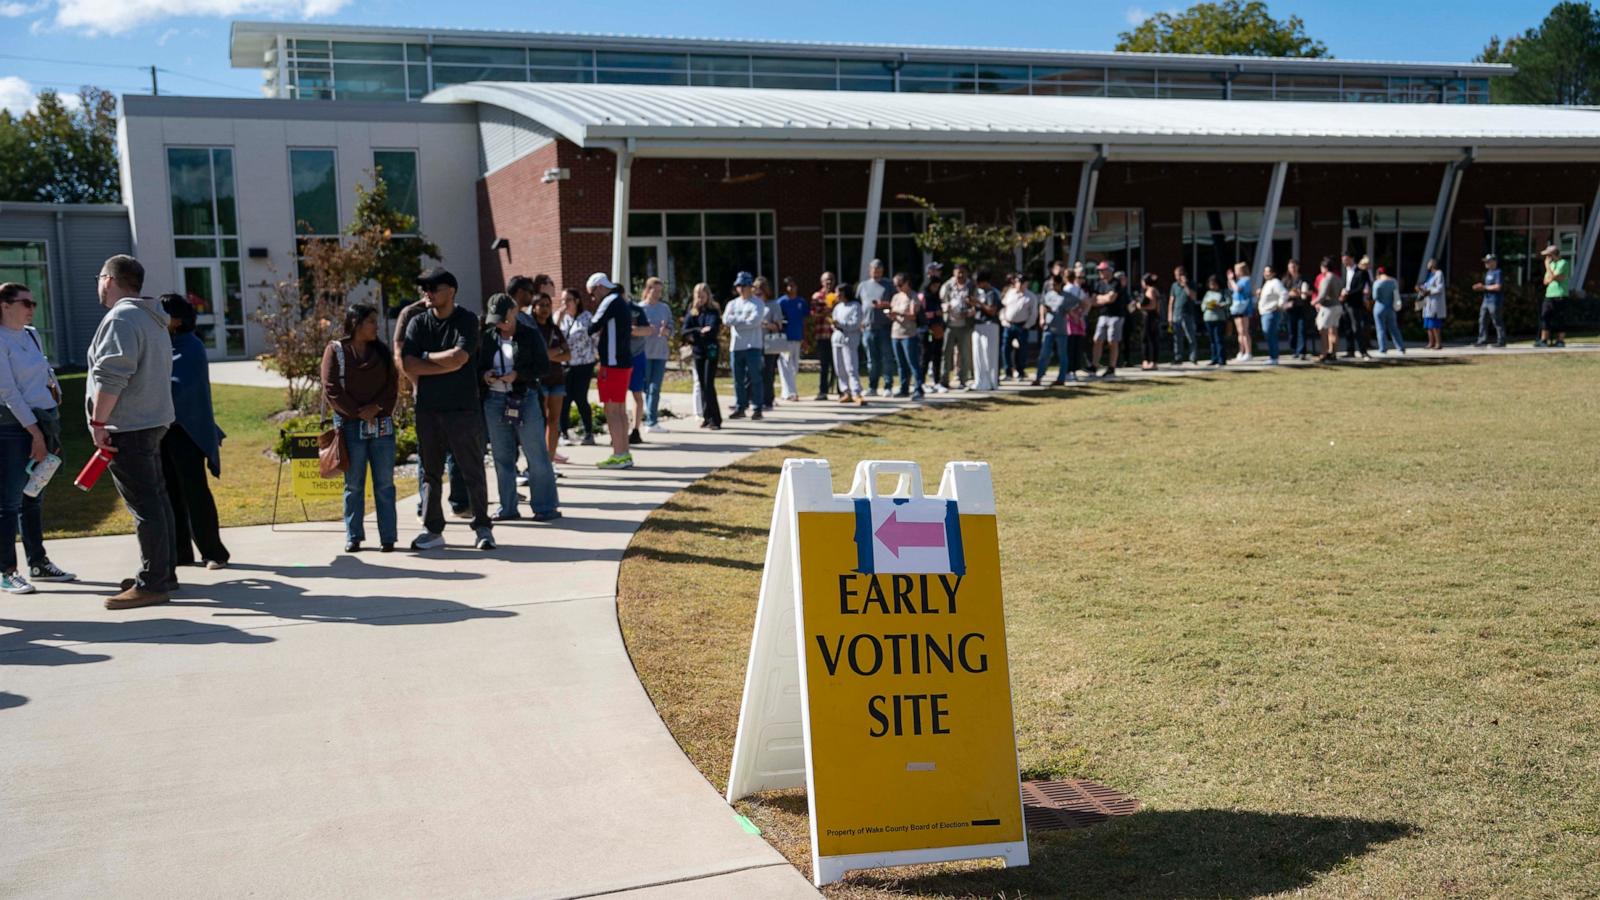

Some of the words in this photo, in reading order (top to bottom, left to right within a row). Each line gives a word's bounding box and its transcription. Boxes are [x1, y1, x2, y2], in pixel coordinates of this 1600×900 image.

[312, 480, 329, 489] THIS
[838, 574, 962, 614] EARLY
[815, 632, 988, 676] VOTING
[867, 693, 951, 738] SITE
[826, 828, 856, 837] Property
[857, 827, 864, 835] of
[865, 825, 884, 833] Wake
[885, 824, 909, 833] County
[910, 823, 930, 831] Board
[931, 822, 938, 830] of
[939, 820, 970, 829] Elections
